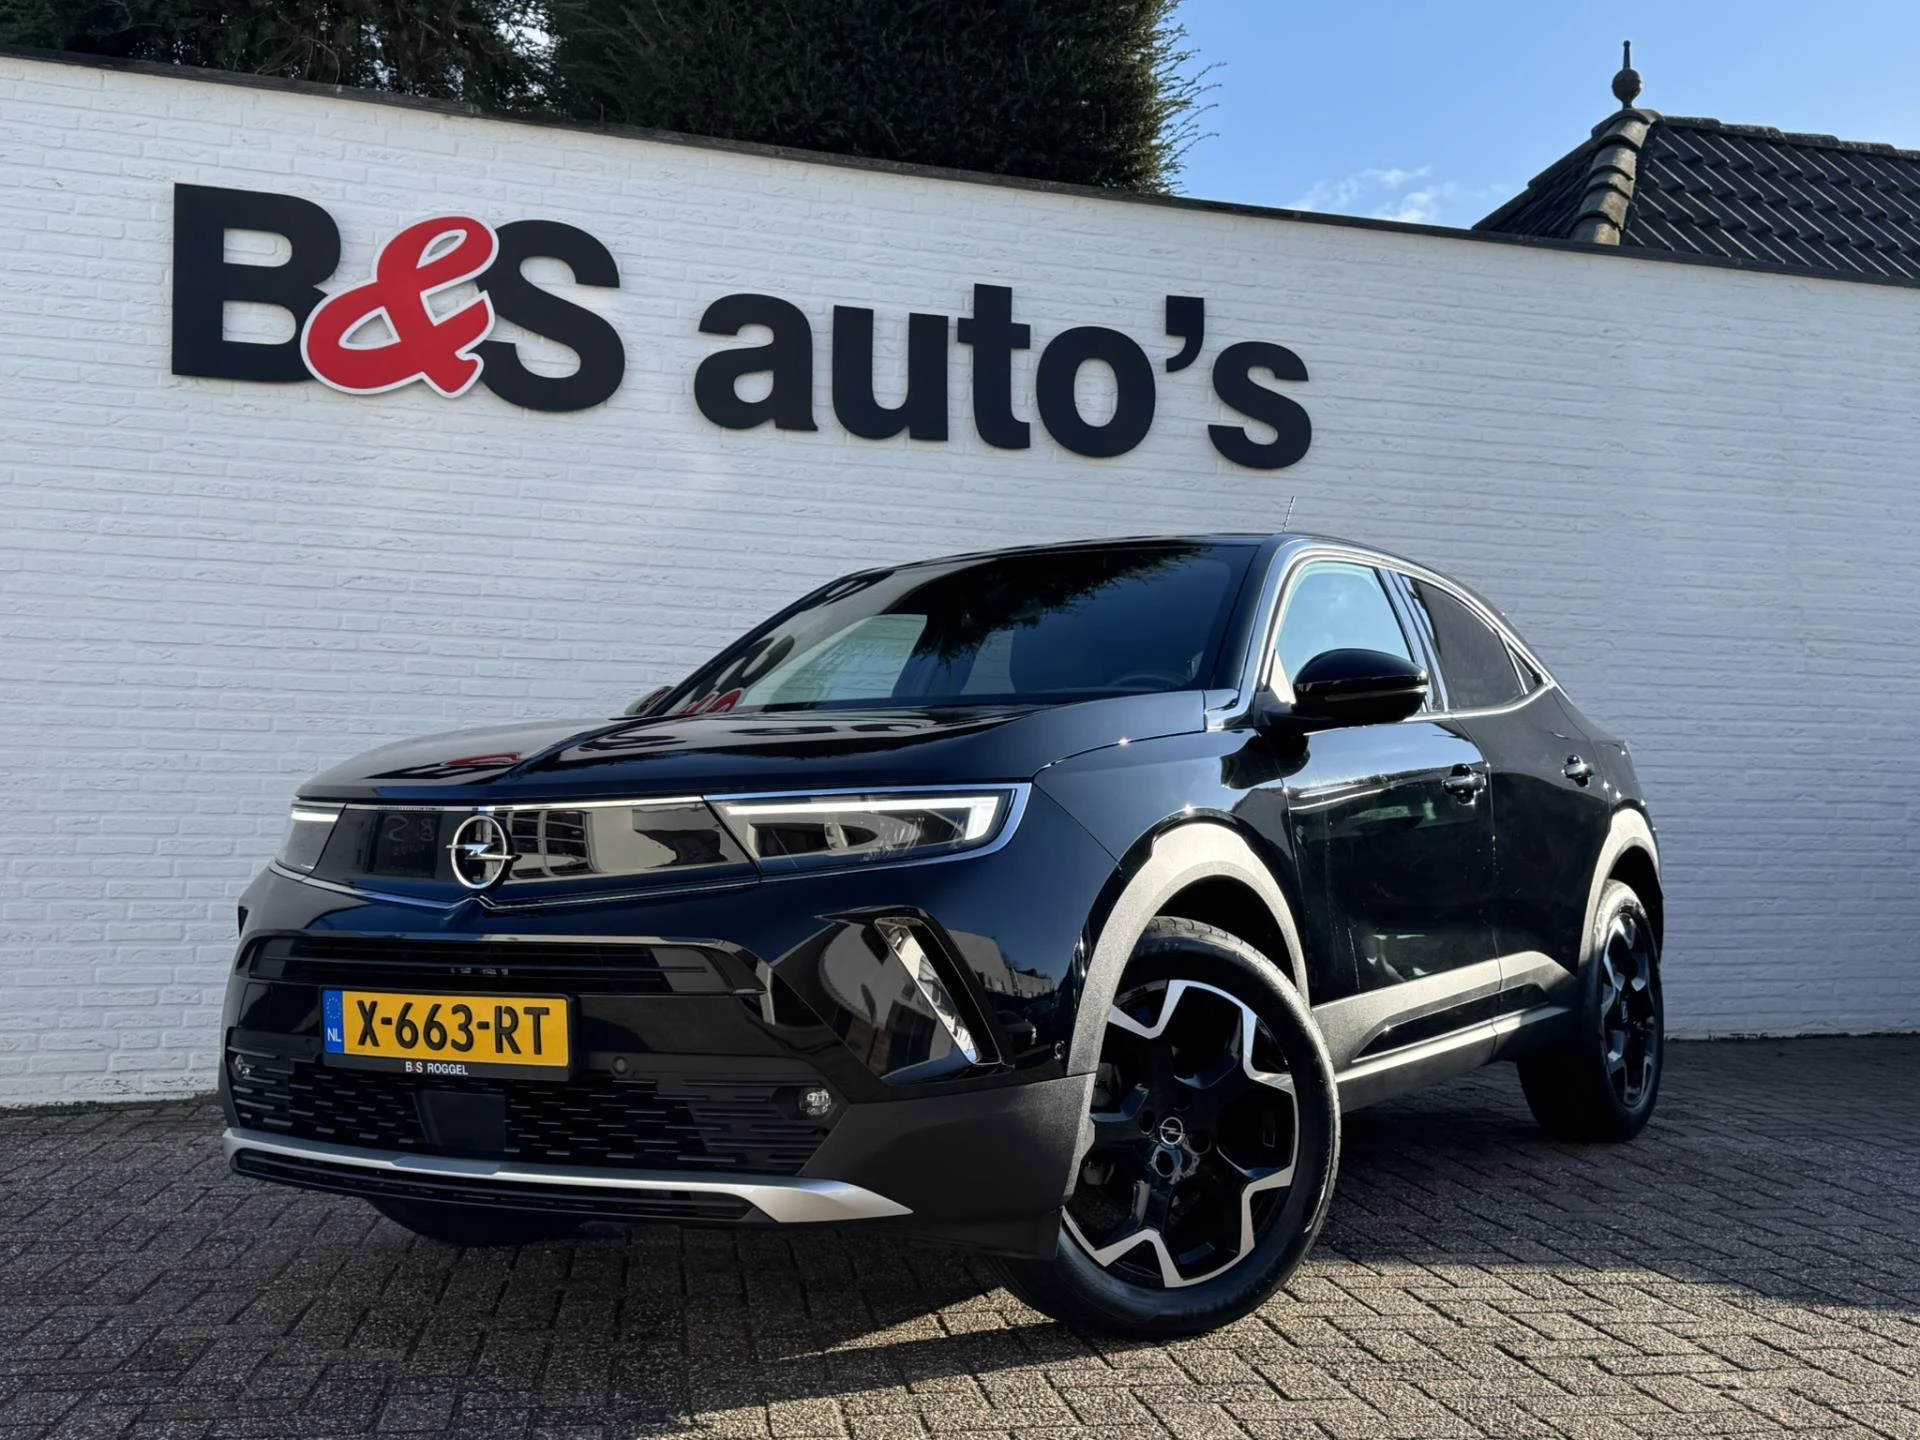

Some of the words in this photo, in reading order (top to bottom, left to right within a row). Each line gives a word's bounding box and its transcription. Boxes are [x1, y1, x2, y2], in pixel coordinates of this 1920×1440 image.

[171, 183, 626, 412] B&S
[694, 283, 1312, 470] auto's
[327, 1027, 342, 1043] NL
[357, 1000, 550, 1055] X-663-RT
[427, 1063, 468, 1075] ROGGEL
